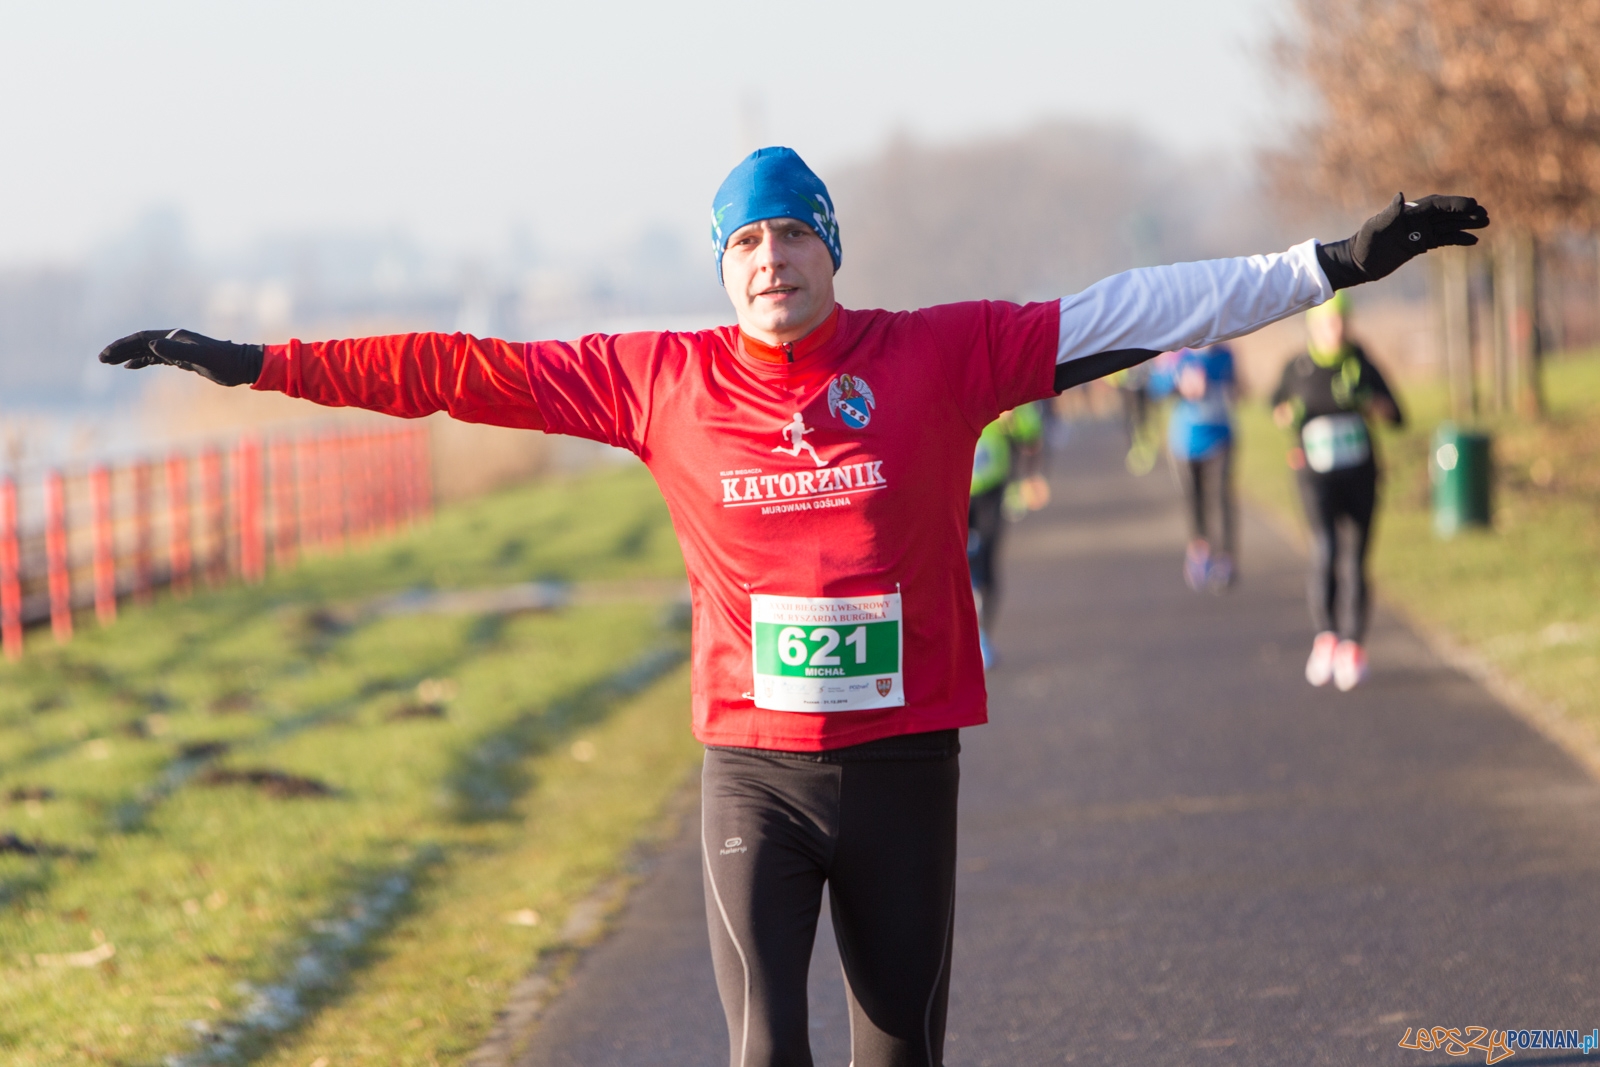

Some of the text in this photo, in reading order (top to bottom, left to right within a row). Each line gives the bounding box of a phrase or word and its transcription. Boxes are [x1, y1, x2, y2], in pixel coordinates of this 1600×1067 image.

[761, 502, 812, 515] MUROWANA
[795, 603, 817, 612] BIEG
[819, 600, 891, 612] SYLWESTROWY
[788, 614, 837, 622] RYSZARDA
[778, 626, 867, 666] 621
[805, 667, 846, 677] MICHAŁ
